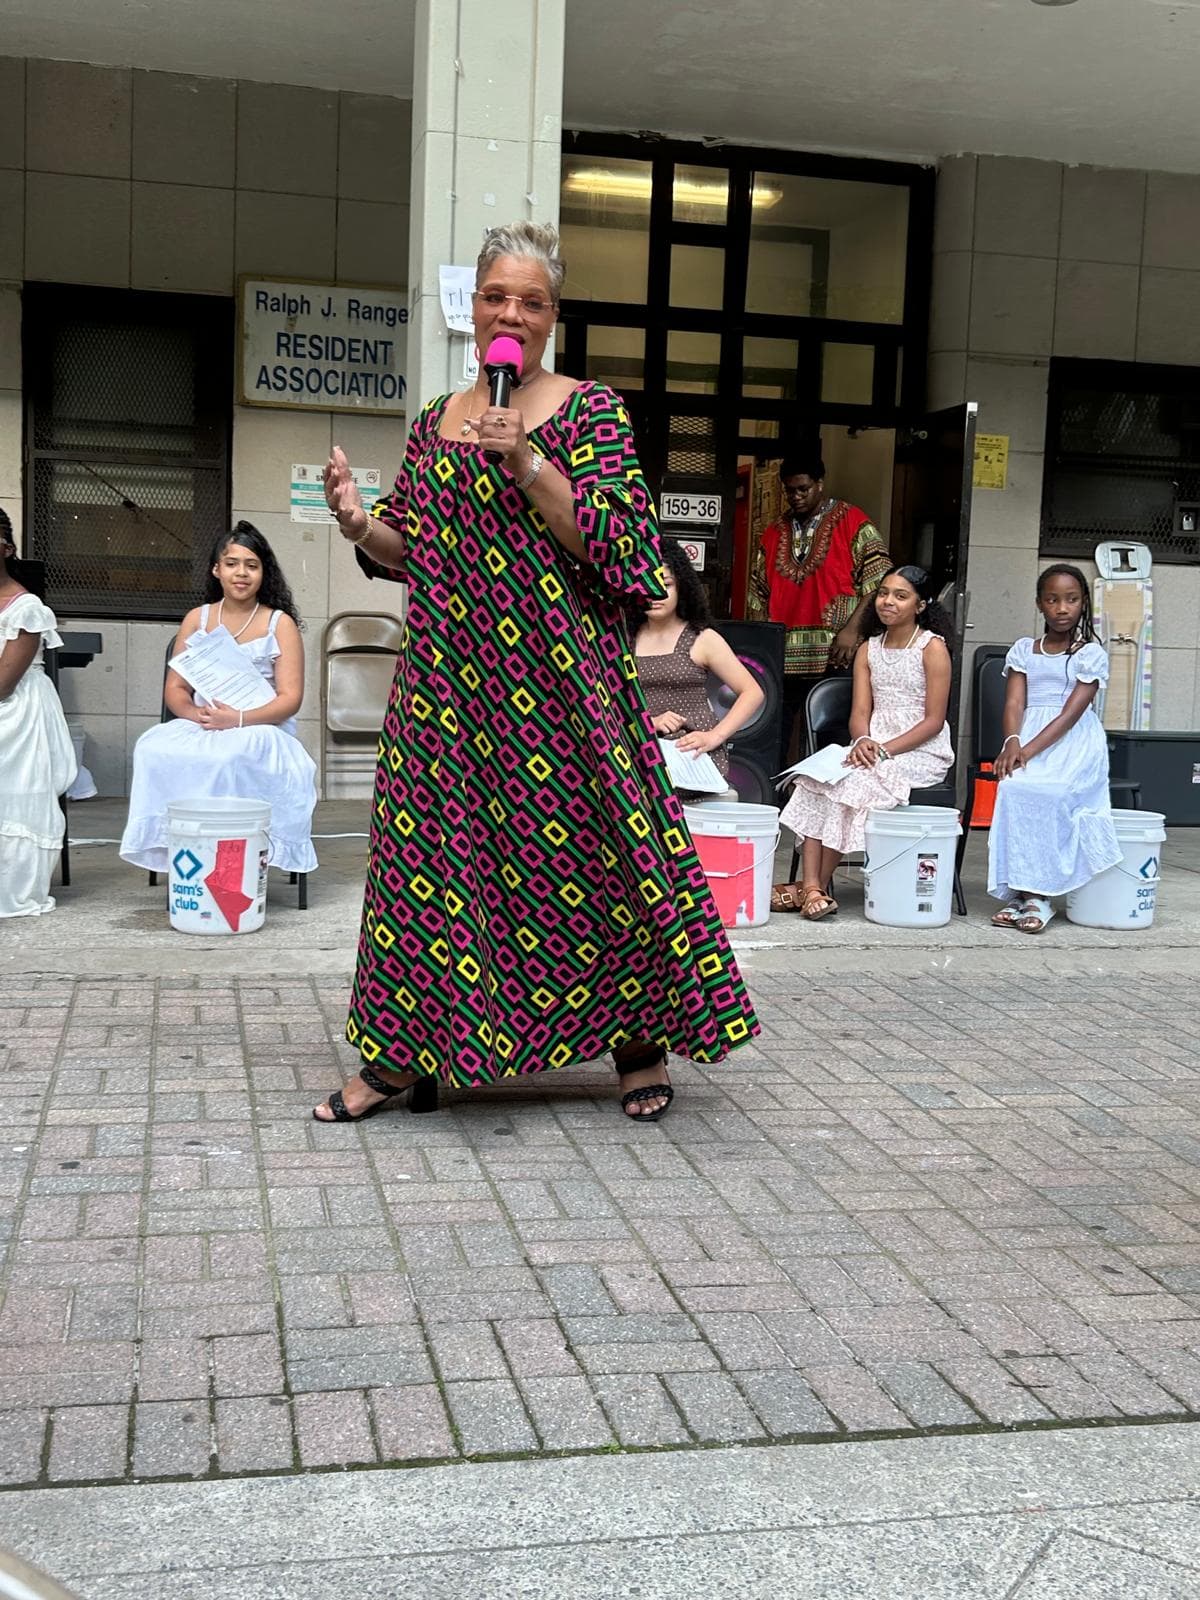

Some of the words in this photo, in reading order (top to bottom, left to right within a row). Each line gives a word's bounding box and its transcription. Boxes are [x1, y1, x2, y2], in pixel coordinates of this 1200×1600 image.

[255, 290, 311, 317] Ralph
[321, 297, 337, 318] J.
[348, 298, 409, 328] Range
[276, 331, 394, 366] RESIDENT
[665, 498, 717, 518] 159-36
[172, 883, 203, 896] sam's
[175, 897, 198, 910] club
